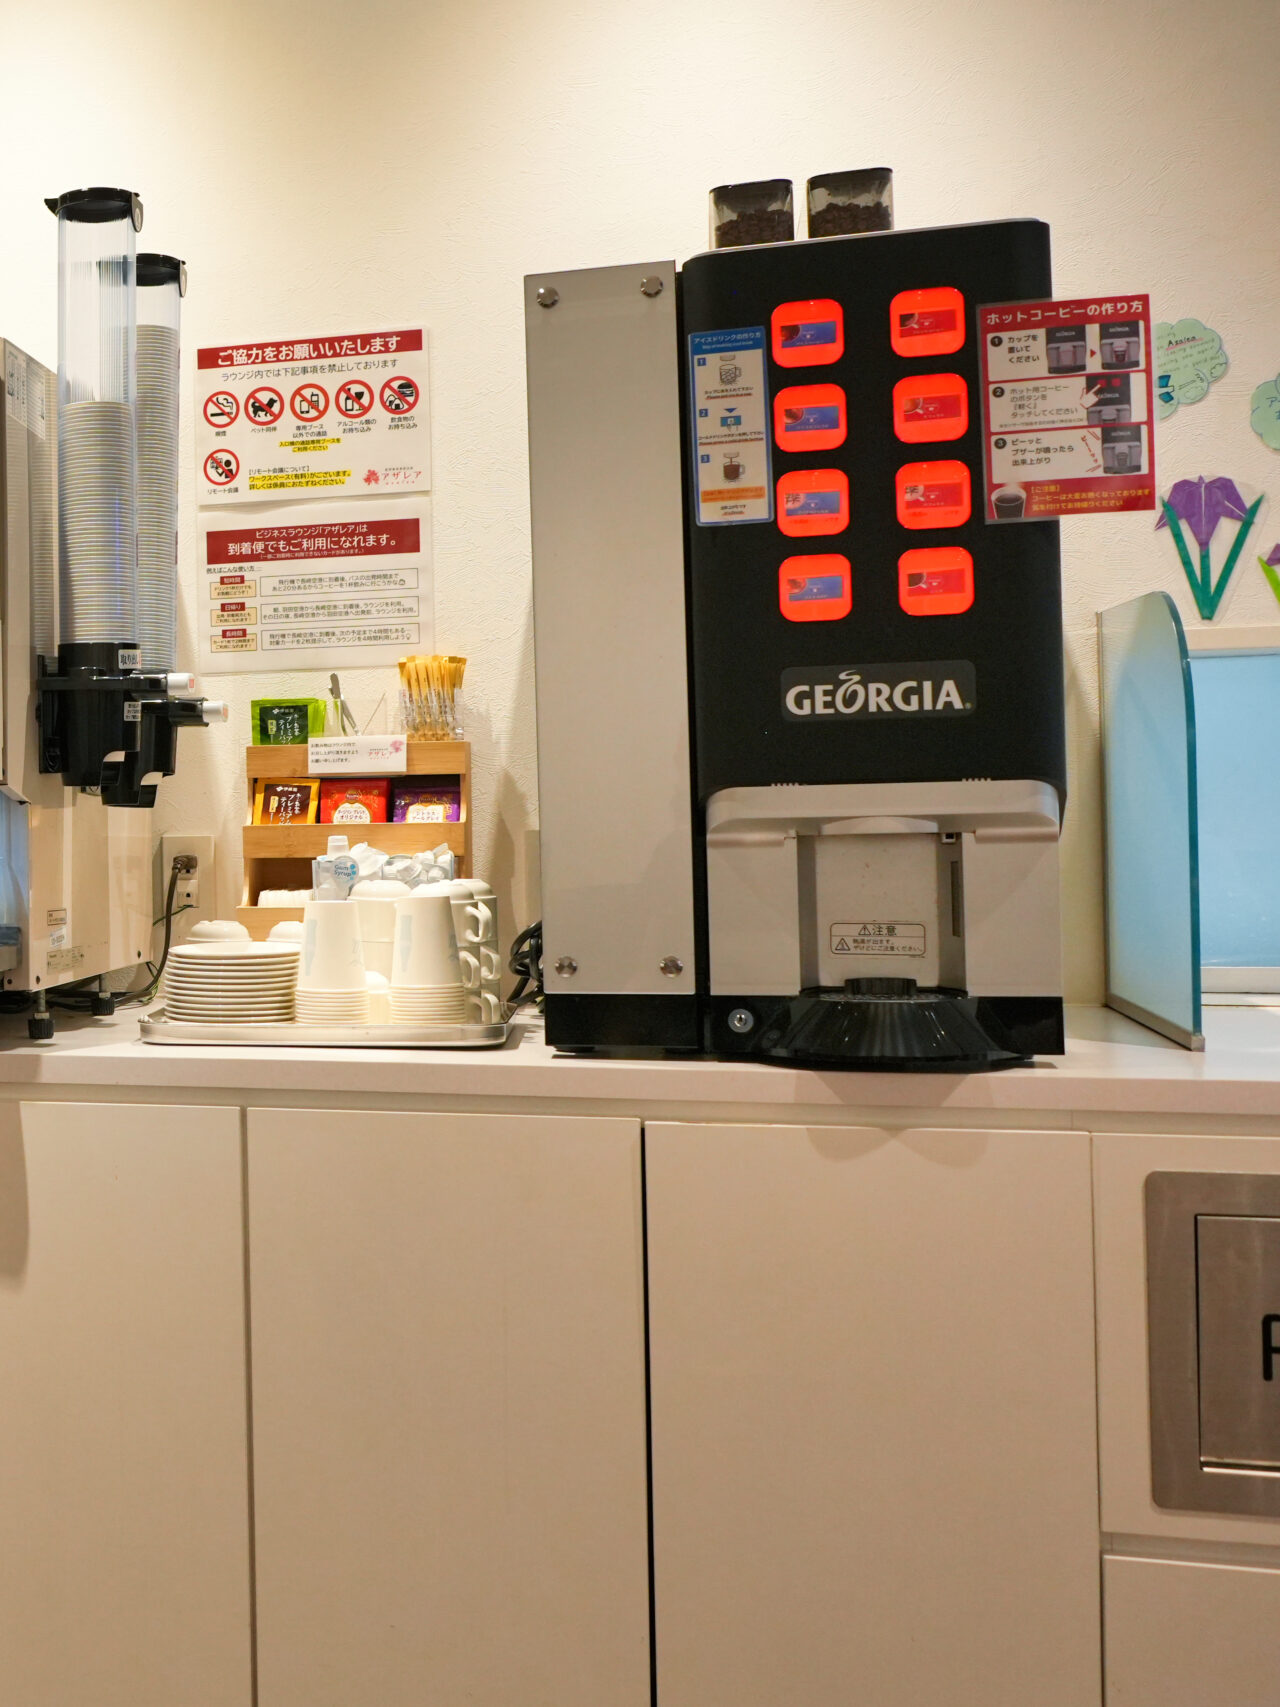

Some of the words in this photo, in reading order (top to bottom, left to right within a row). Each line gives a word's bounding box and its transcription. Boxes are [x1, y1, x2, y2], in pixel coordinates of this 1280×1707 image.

[986, 301, 1143, 326] ホットコーヒーの作り方
[1007, 334, 1038, 343] カップを
[217, 335, 401, 366] ご協力をお願いいたします
[1008, 355, 1040, 363] ください
[221, 359, 398, 382] ラウンジ内では下記事項を禁止しております
[256, 524, 368, 539] ビジネスラウンジ「アザレア」は
[227, 534, 397, 556] 到着便でもご利用になれます。
[785, 670, 965, 716] GEORGIA
[872, 924, 897, 936] 注意
